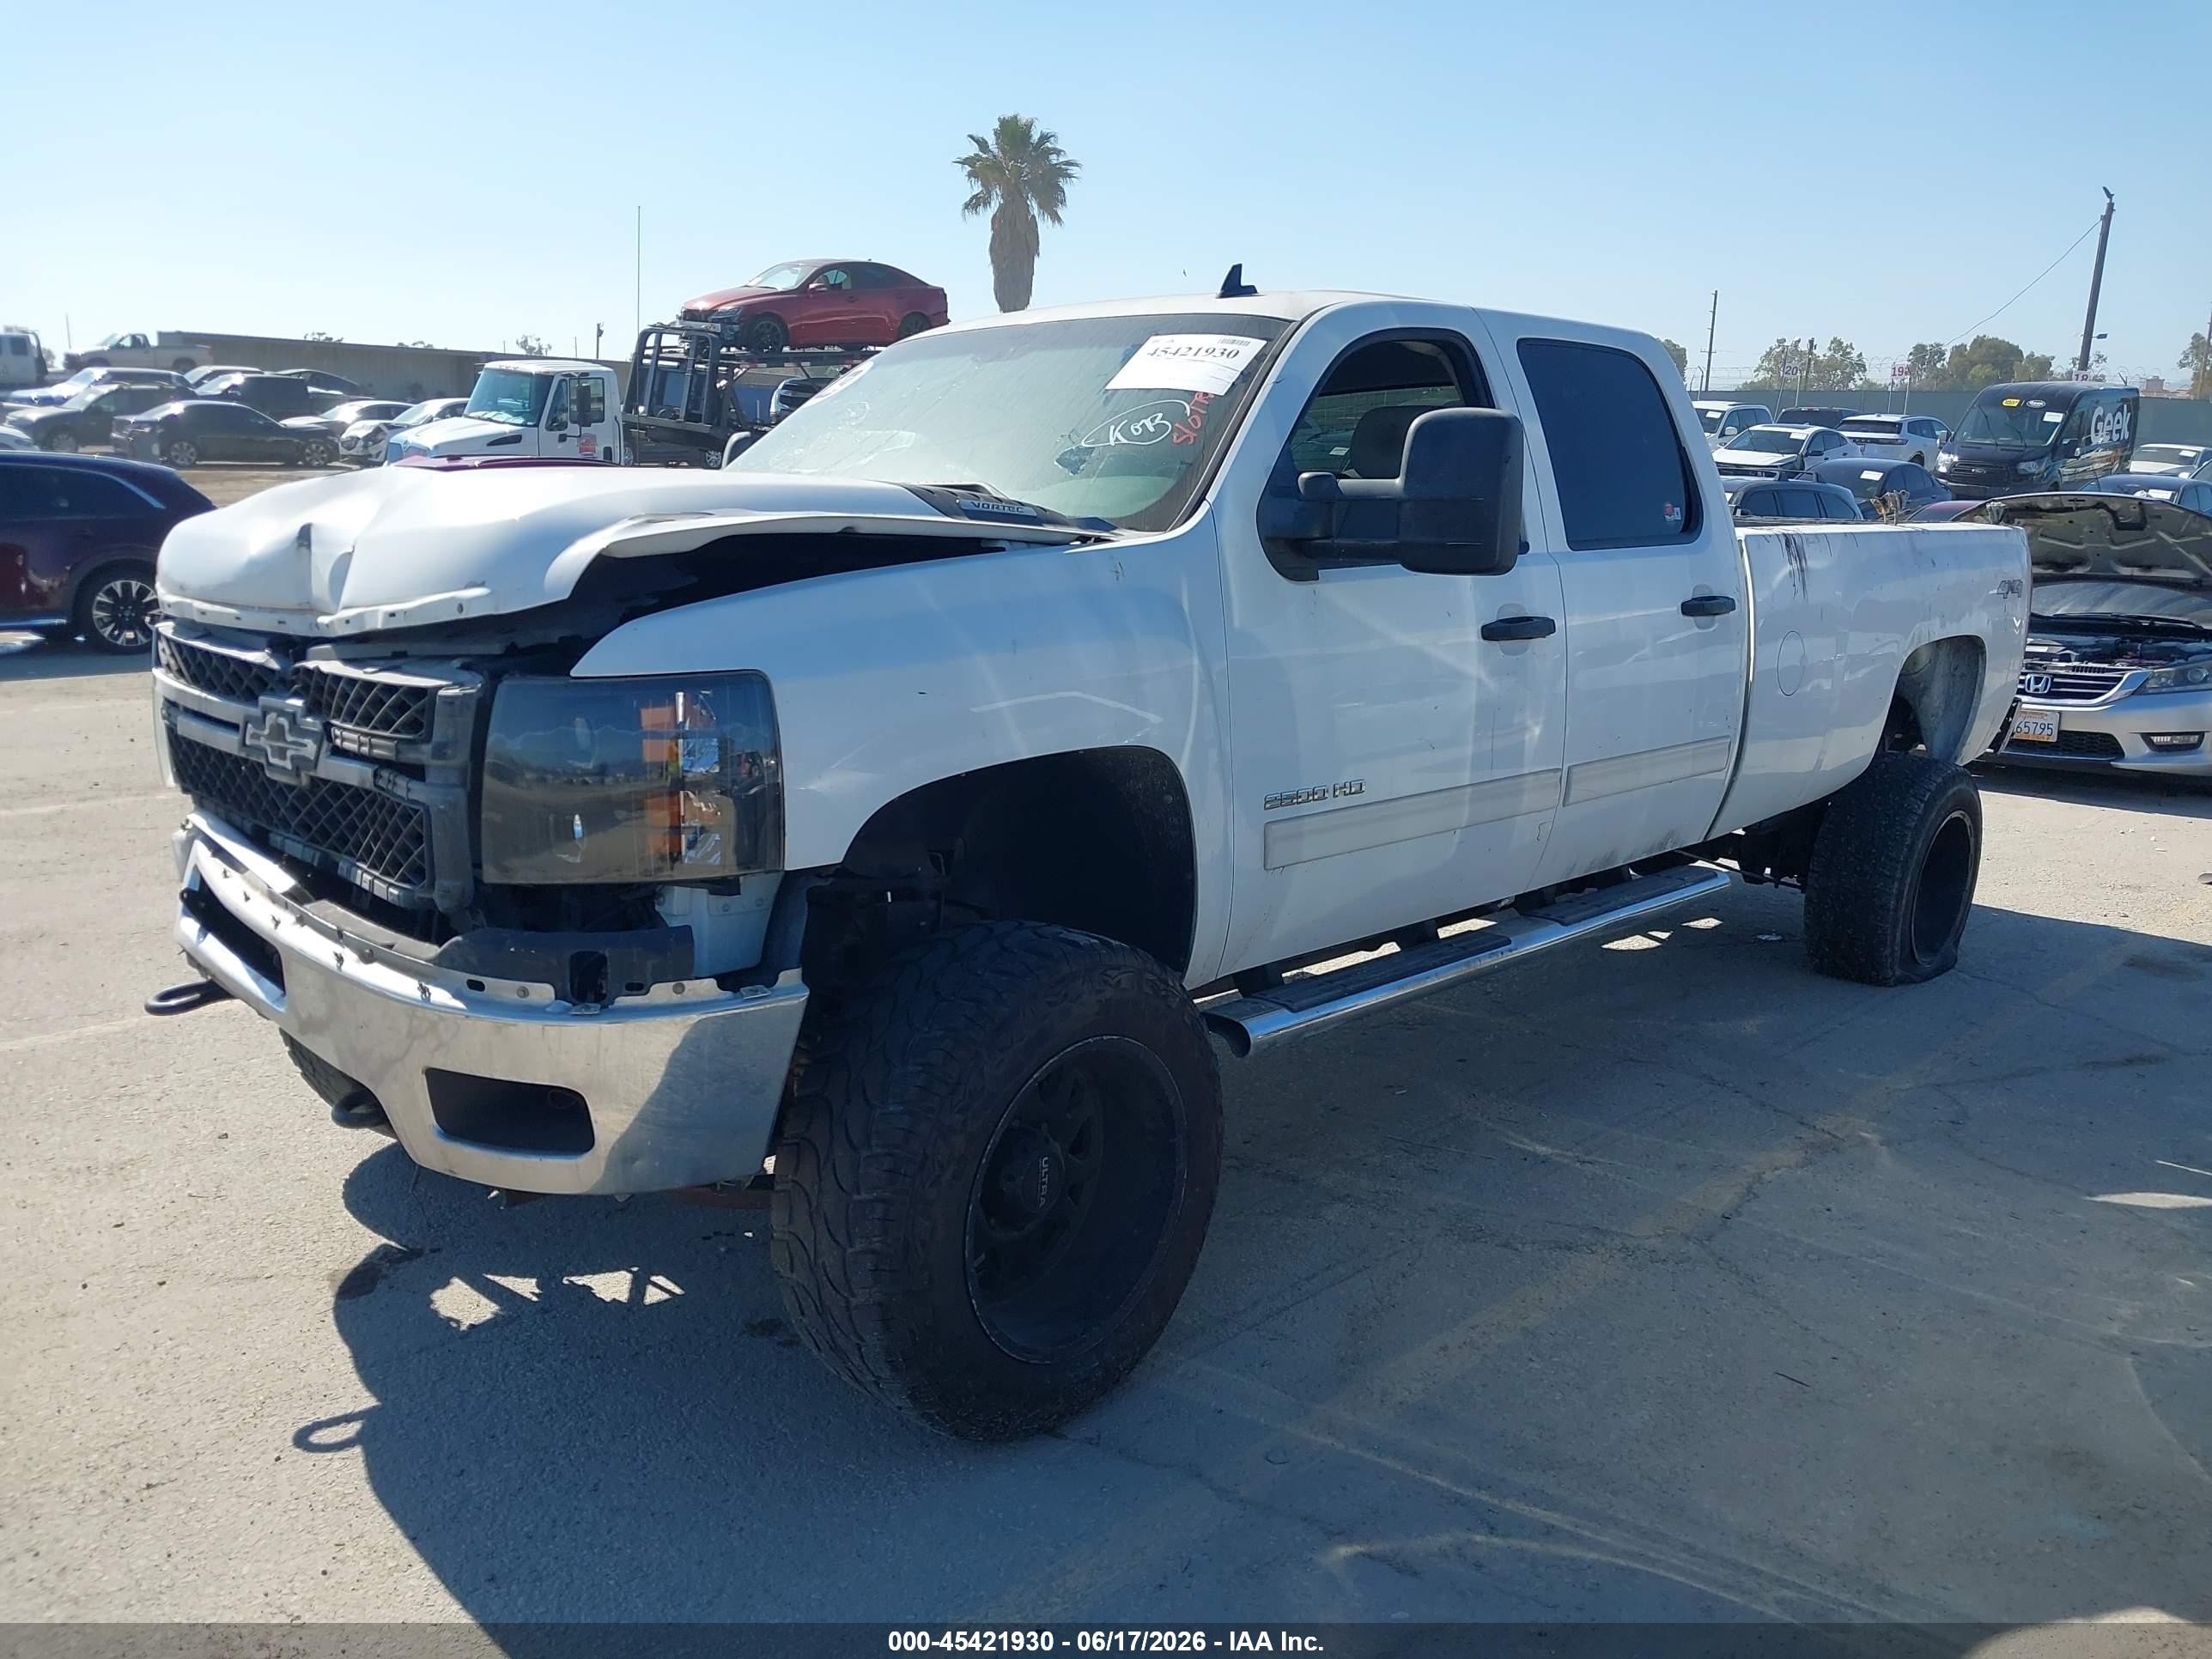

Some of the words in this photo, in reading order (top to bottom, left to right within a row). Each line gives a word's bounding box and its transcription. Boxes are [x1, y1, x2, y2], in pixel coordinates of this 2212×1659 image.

[1146, 346, 1240, 360] 45421930
[2090, 404, 2131, 444] Geek
[969, 501, 1024, 514] VORTEC
[2015, 720, 2054, 737] 65795
[1263, 785, 1329, 811] 2500
[1332, 779, 1367, 799] HD
[1039, 1156, 1048, 1209] ULTRA
